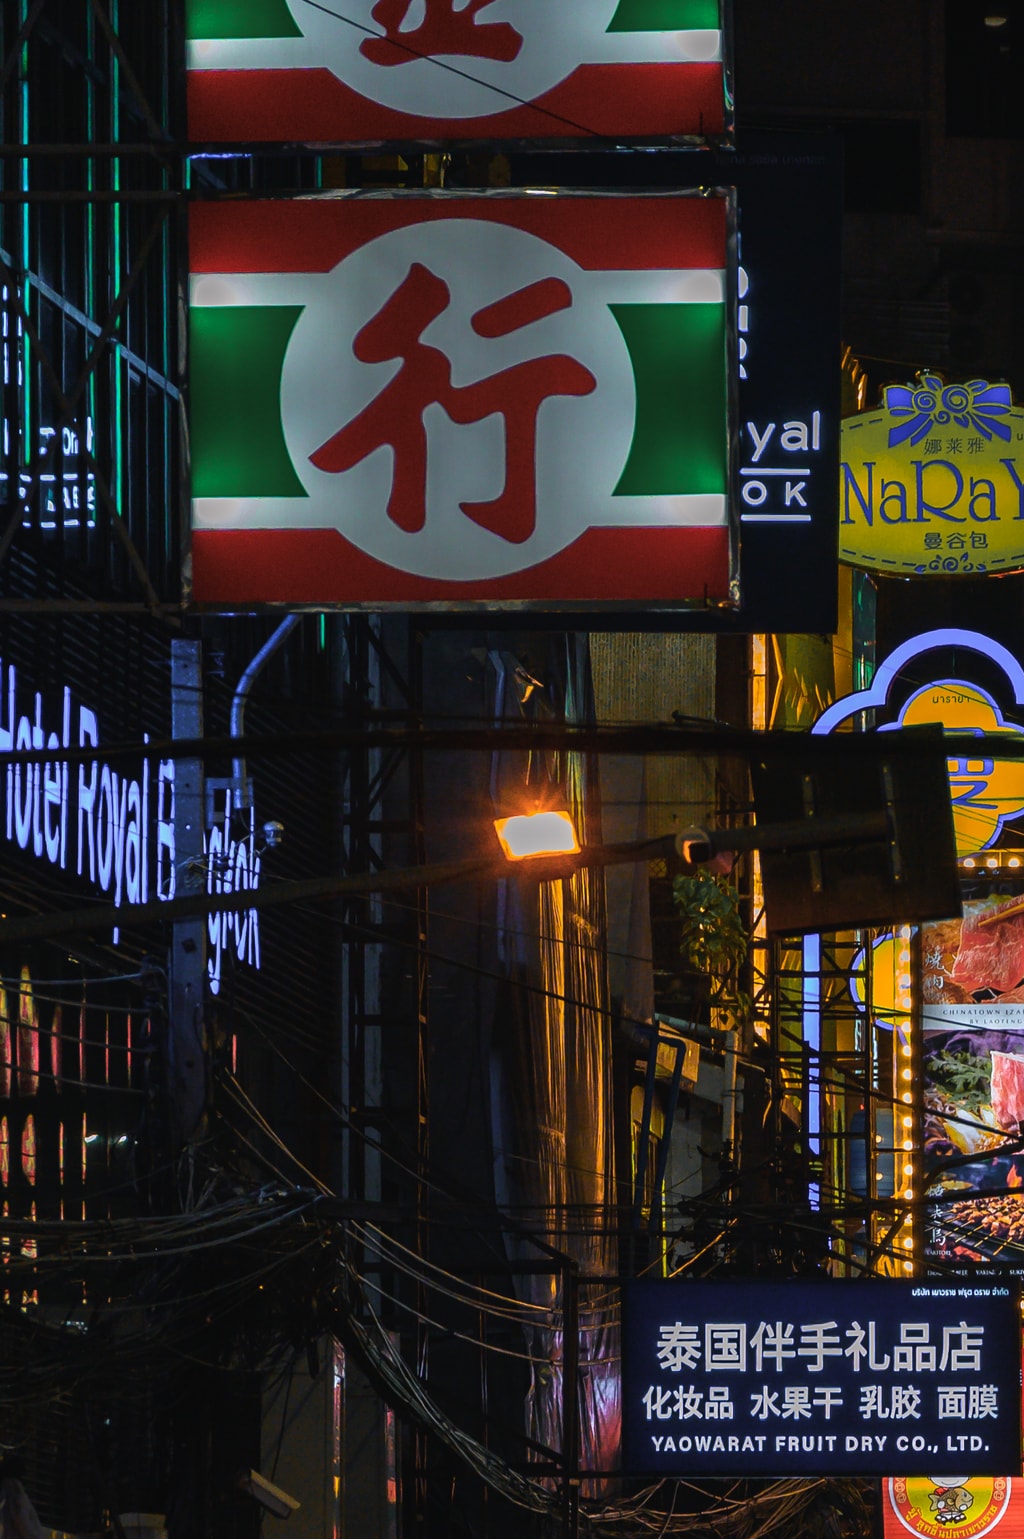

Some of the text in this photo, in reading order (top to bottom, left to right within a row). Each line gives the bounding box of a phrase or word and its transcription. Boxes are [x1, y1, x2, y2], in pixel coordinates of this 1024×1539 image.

[308, 262, 597, 545] 行
[923, 532, 989, 551] 曼谷包
[942, 1008, 1001, 1016] CHINATOWN
[656, 1320, 985, 1372] 泰国伴手礼品店
[642, 1384, 1000, 1421] 化妆品 水果干 乳胶 面膜
[651, 1436, 991, 1454] YAOWARAT FRUIT DRY CO., LTD.
